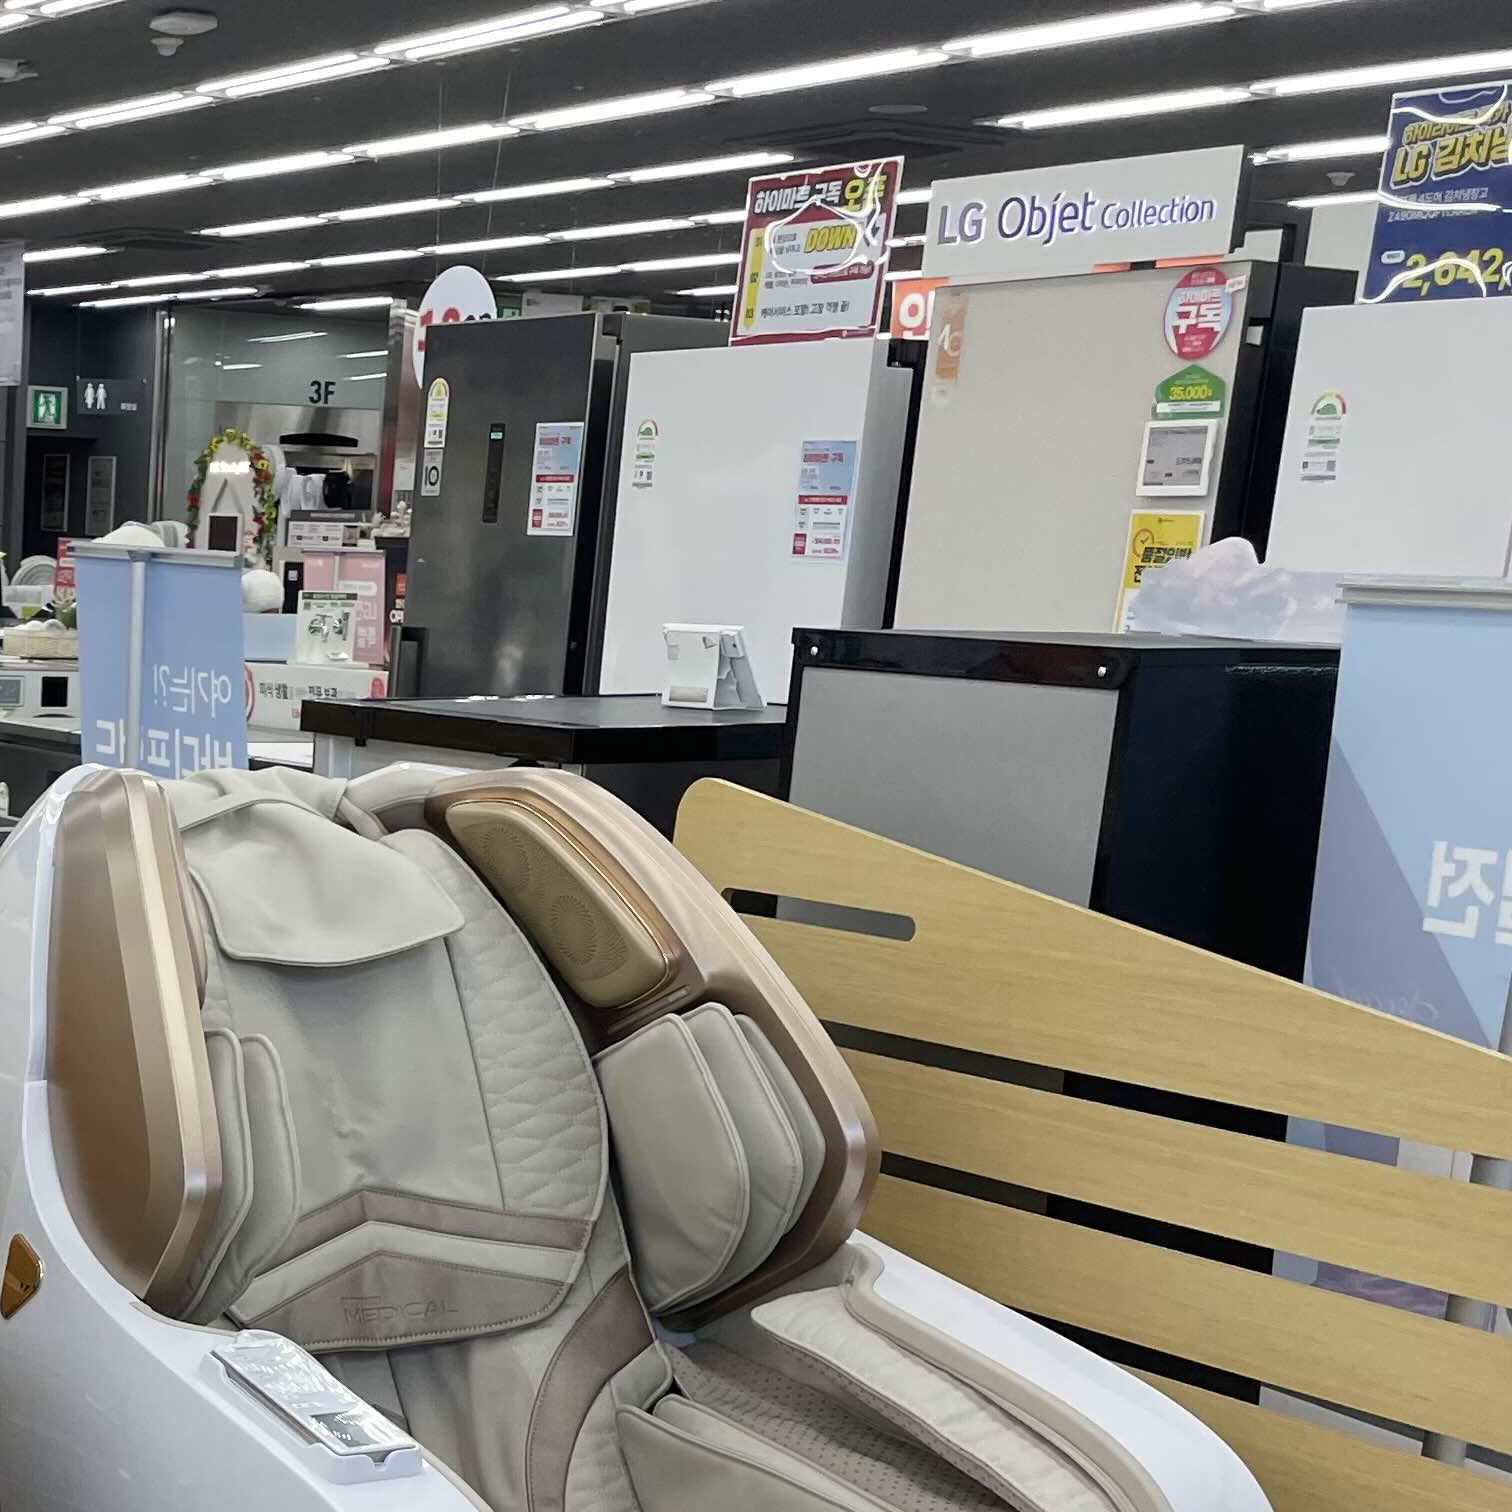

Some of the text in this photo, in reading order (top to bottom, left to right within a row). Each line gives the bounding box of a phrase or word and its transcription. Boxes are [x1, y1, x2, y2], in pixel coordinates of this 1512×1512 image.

[1391, 147, 1430, 184] LG
[753, 185, 811, 214] 하이마트
[815, 180, 843, 204] 구독
[937, 201, 986, 246] LG
[1100, 195, 1217, 230] Collection
[804, 223, 857, 254] DOWN
[1171, 303, 1223, 334] 구독
[308, 379, 337, 405] 3F
